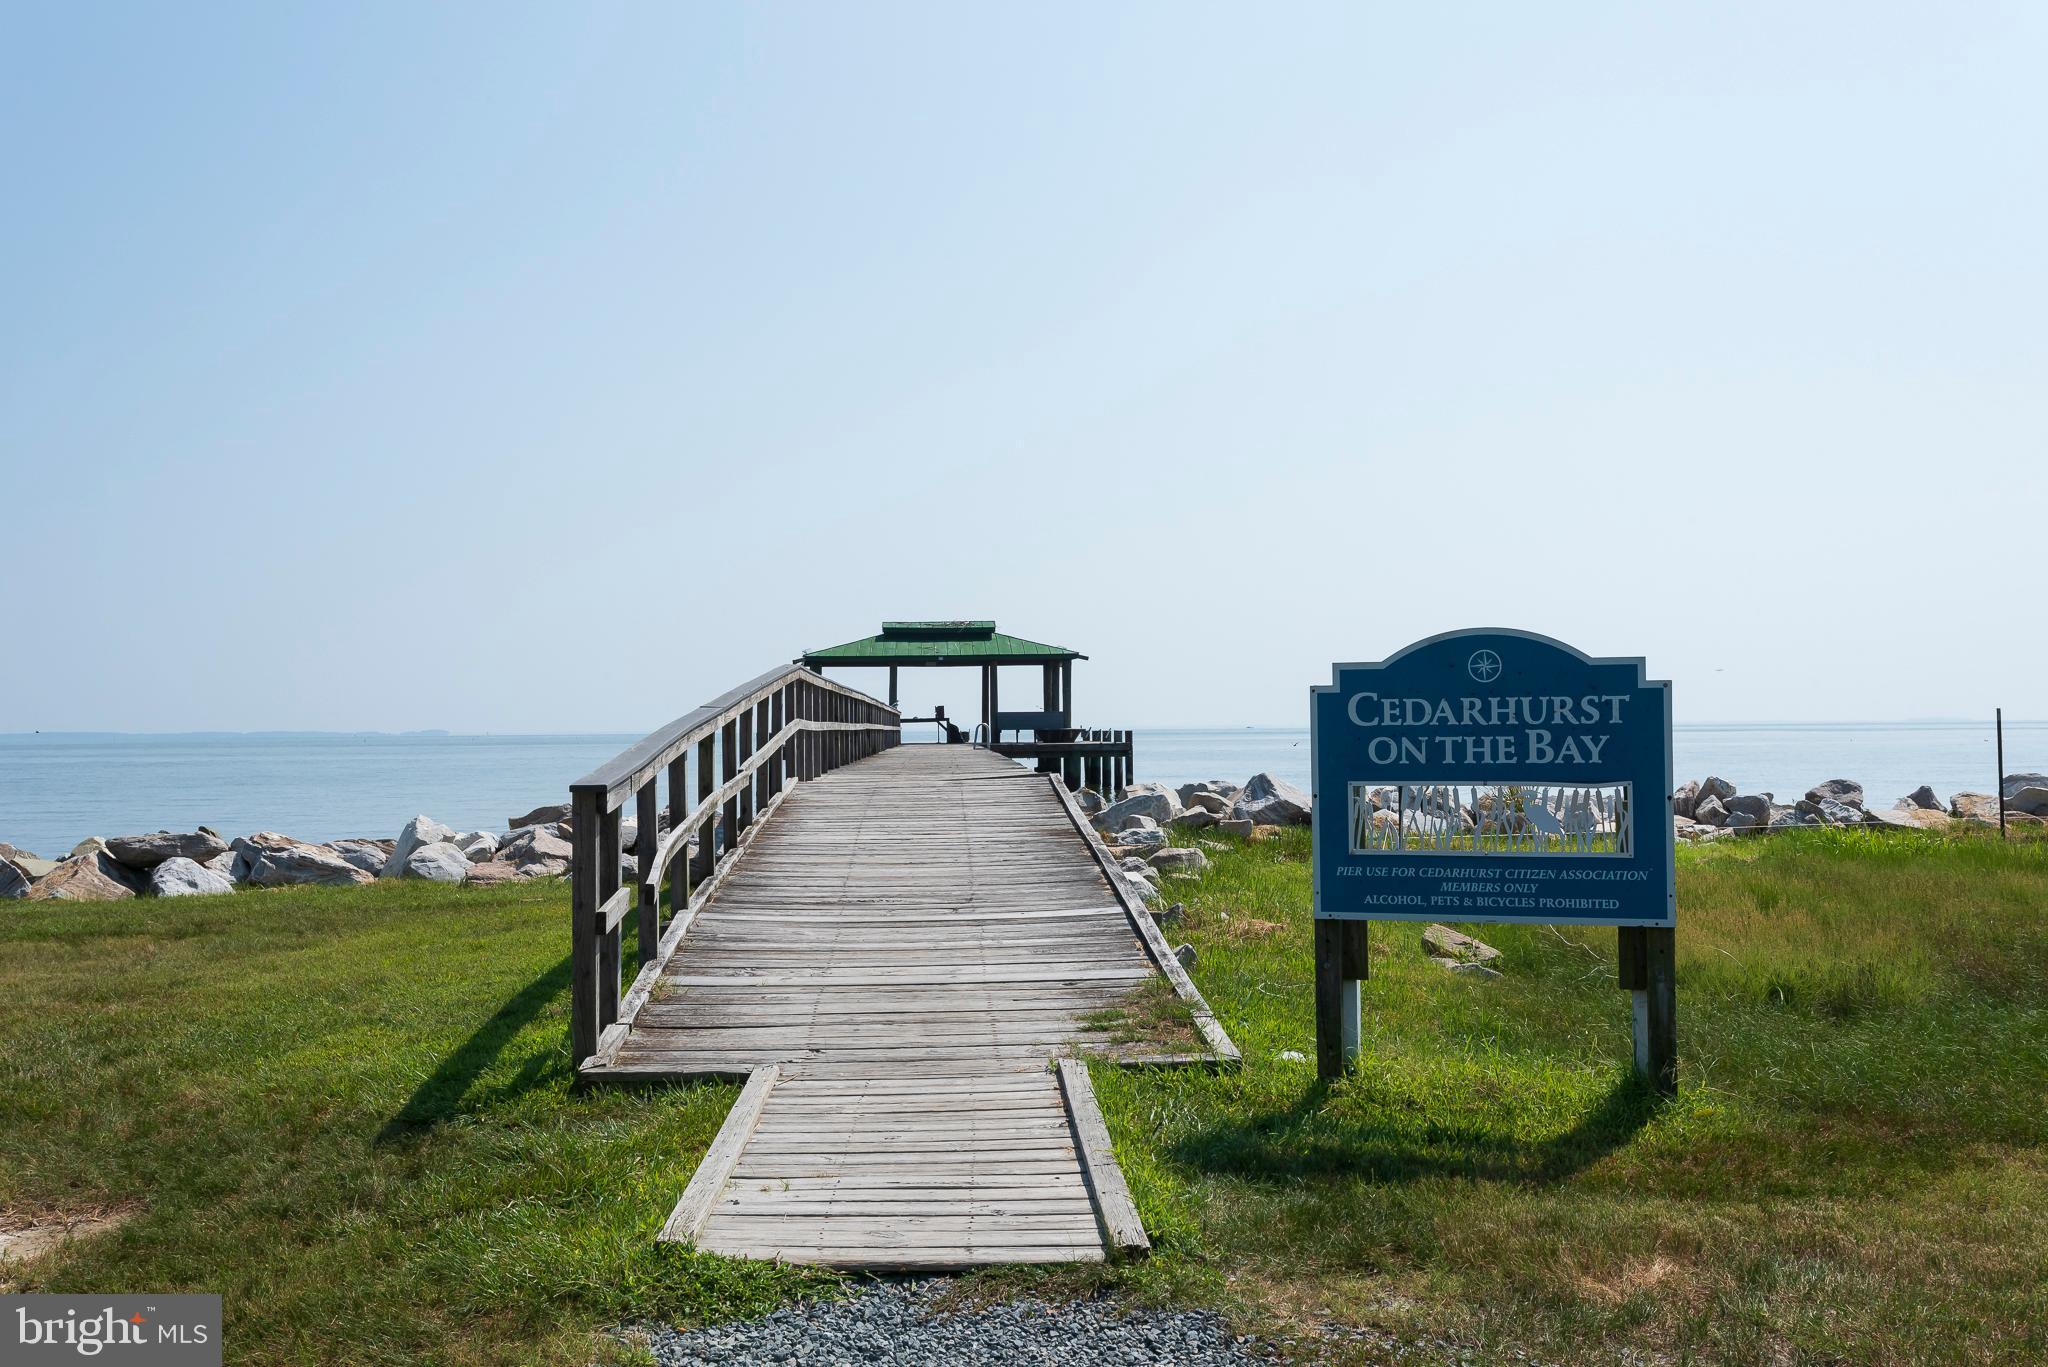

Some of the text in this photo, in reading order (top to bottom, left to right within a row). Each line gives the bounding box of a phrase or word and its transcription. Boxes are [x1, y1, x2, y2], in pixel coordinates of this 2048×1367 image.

[1347, 691, 1630, 727] CEDARHURST
[1368, 729, 1610, 765] ON THE BAY
[1336, 866, 1650, 881] PIER USE FOR CEDARHURST CITIZEN ASSOCIATION
[1440, 882, 1539, 894] MEMBERS ONLY
[1364, 895, 1619, 909] ALCOHOL, PETS & BICYCLES PROHIBITED
